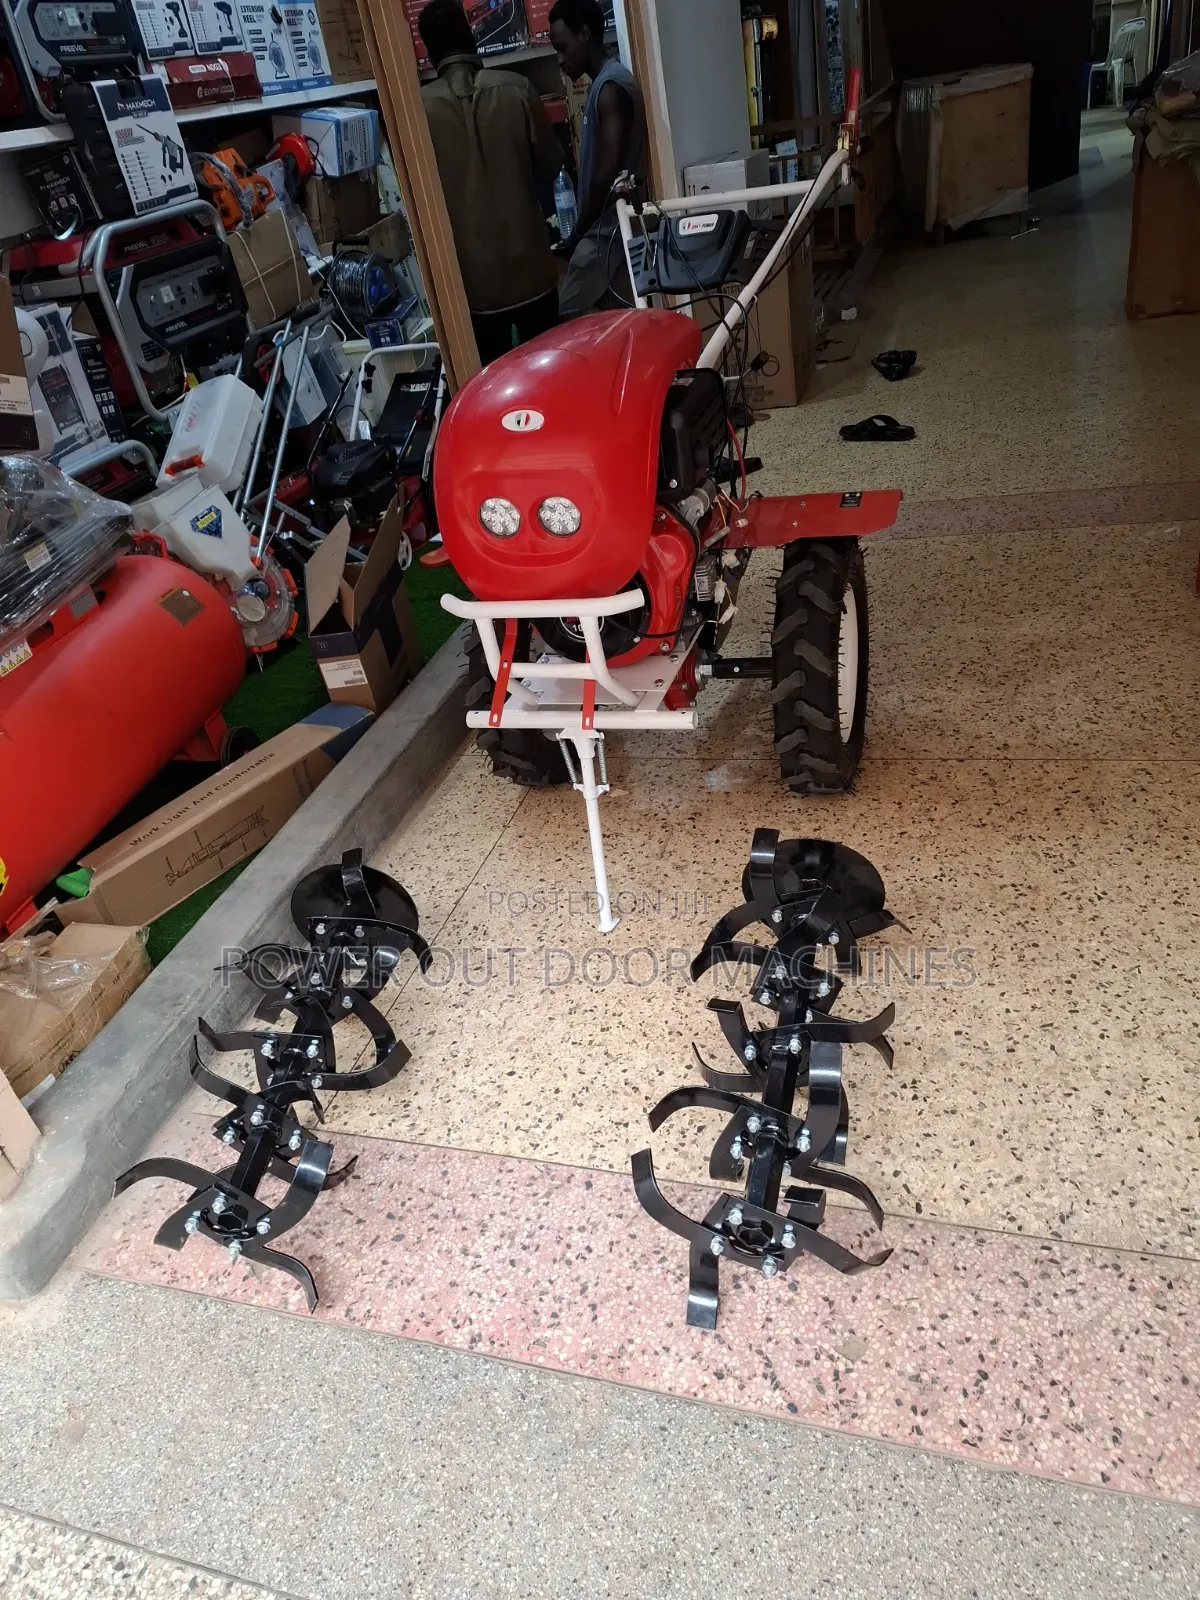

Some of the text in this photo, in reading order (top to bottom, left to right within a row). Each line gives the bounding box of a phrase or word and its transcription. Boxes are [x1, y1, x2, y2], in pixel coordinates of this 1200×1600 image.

[240, 5, 265, 13] EXTENSION
[284, 9, 304, 17] EXTENSION
[242, 14, 257, 24] REEL
[286, 18, 298, 26] REEL
[125, 98, 157, 110] MAXMECH
[129, 827, 160, 846] Work
[161, 805, 191, 826] Light
[191, 791, 214, 806] And
[214, 752, 276, 791] Comfortable
